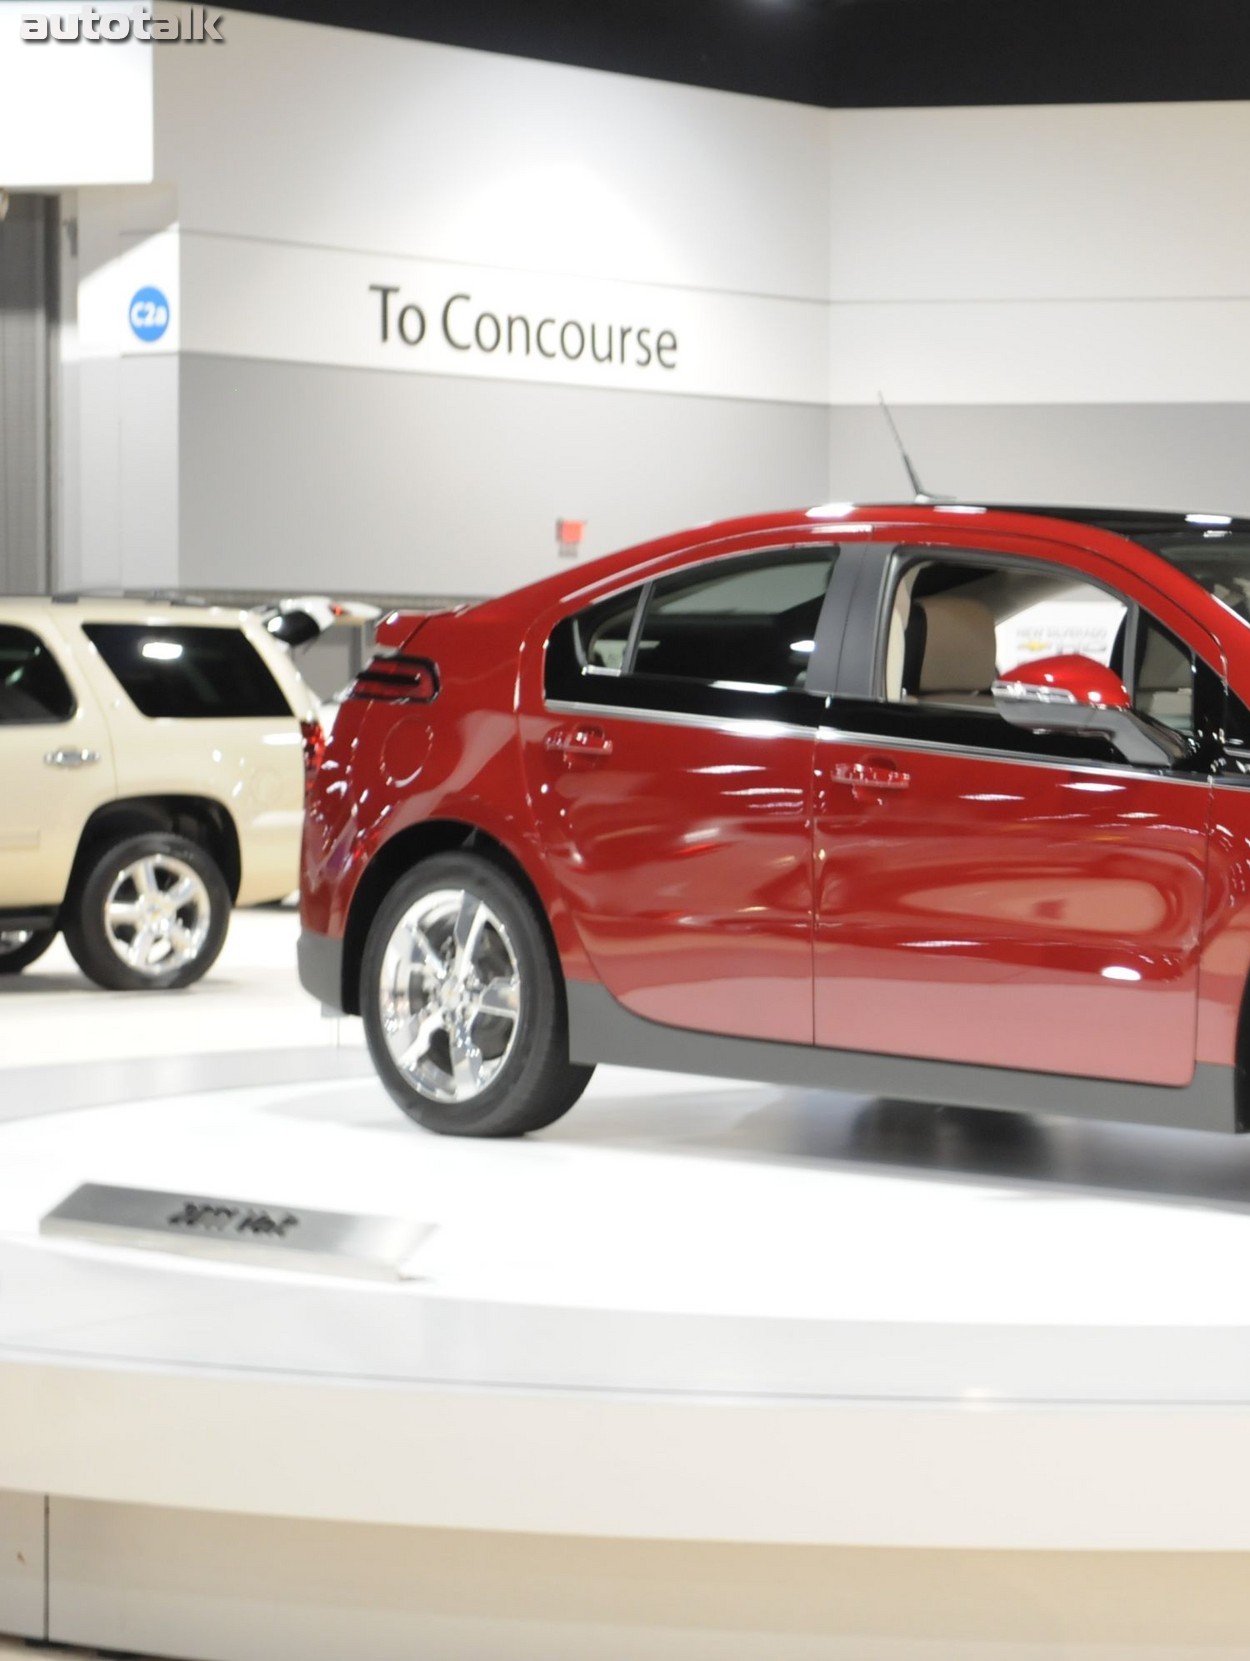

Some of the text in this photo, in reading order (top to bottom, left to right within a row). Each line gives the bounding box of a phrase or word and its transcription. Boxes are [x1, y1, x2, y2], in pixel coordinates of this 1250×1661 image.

[131, 301, 168, 327] C2a
[369, 283, 679, 370] To Concourse
